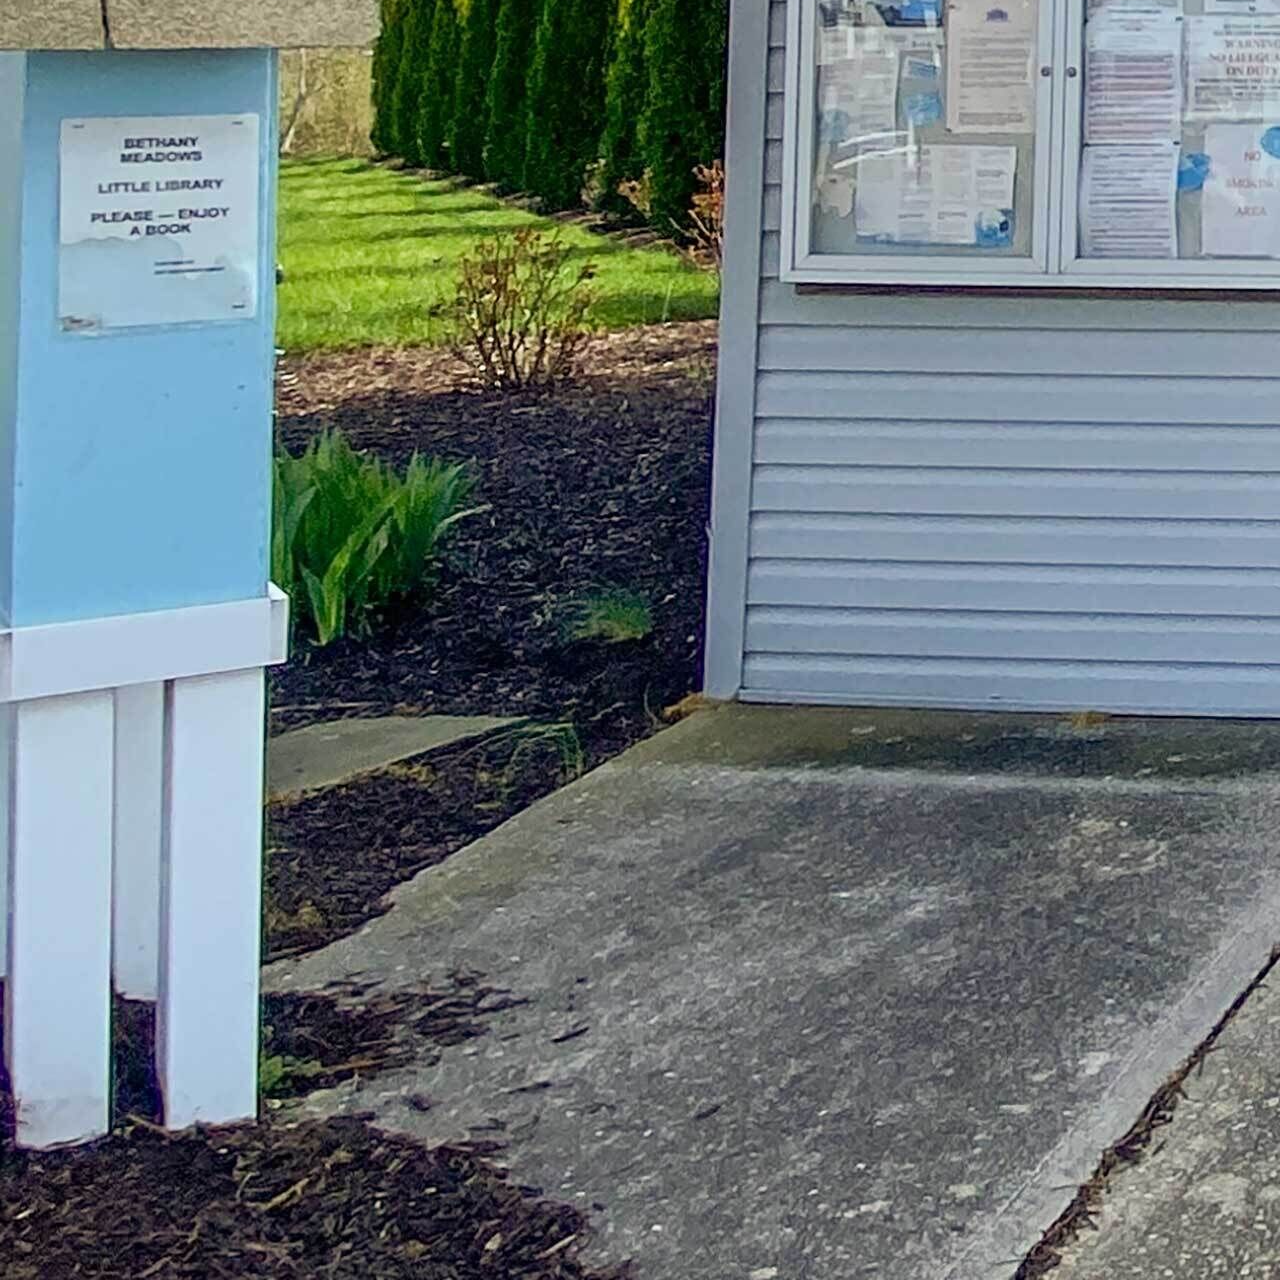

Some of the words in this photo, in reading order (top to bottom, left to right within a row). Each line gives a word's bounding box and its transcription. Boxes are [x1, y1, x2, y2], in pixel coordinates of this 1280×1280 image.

[123, 136, 199, 149] BETHANY
[120, 151, 202, 163] MEADOWS
[98, 181, 150, 194] LITTLE
[155, 178, 224, 192] LIBRARY
[1226, 178, 1279, 189] SMOKIN
[90, 209, 153, 223] PLEASE
[177, 206, 230, 219] ENJOY
[130, 225, 141, 235] A
[145, 223, 191, 235] BOOK
